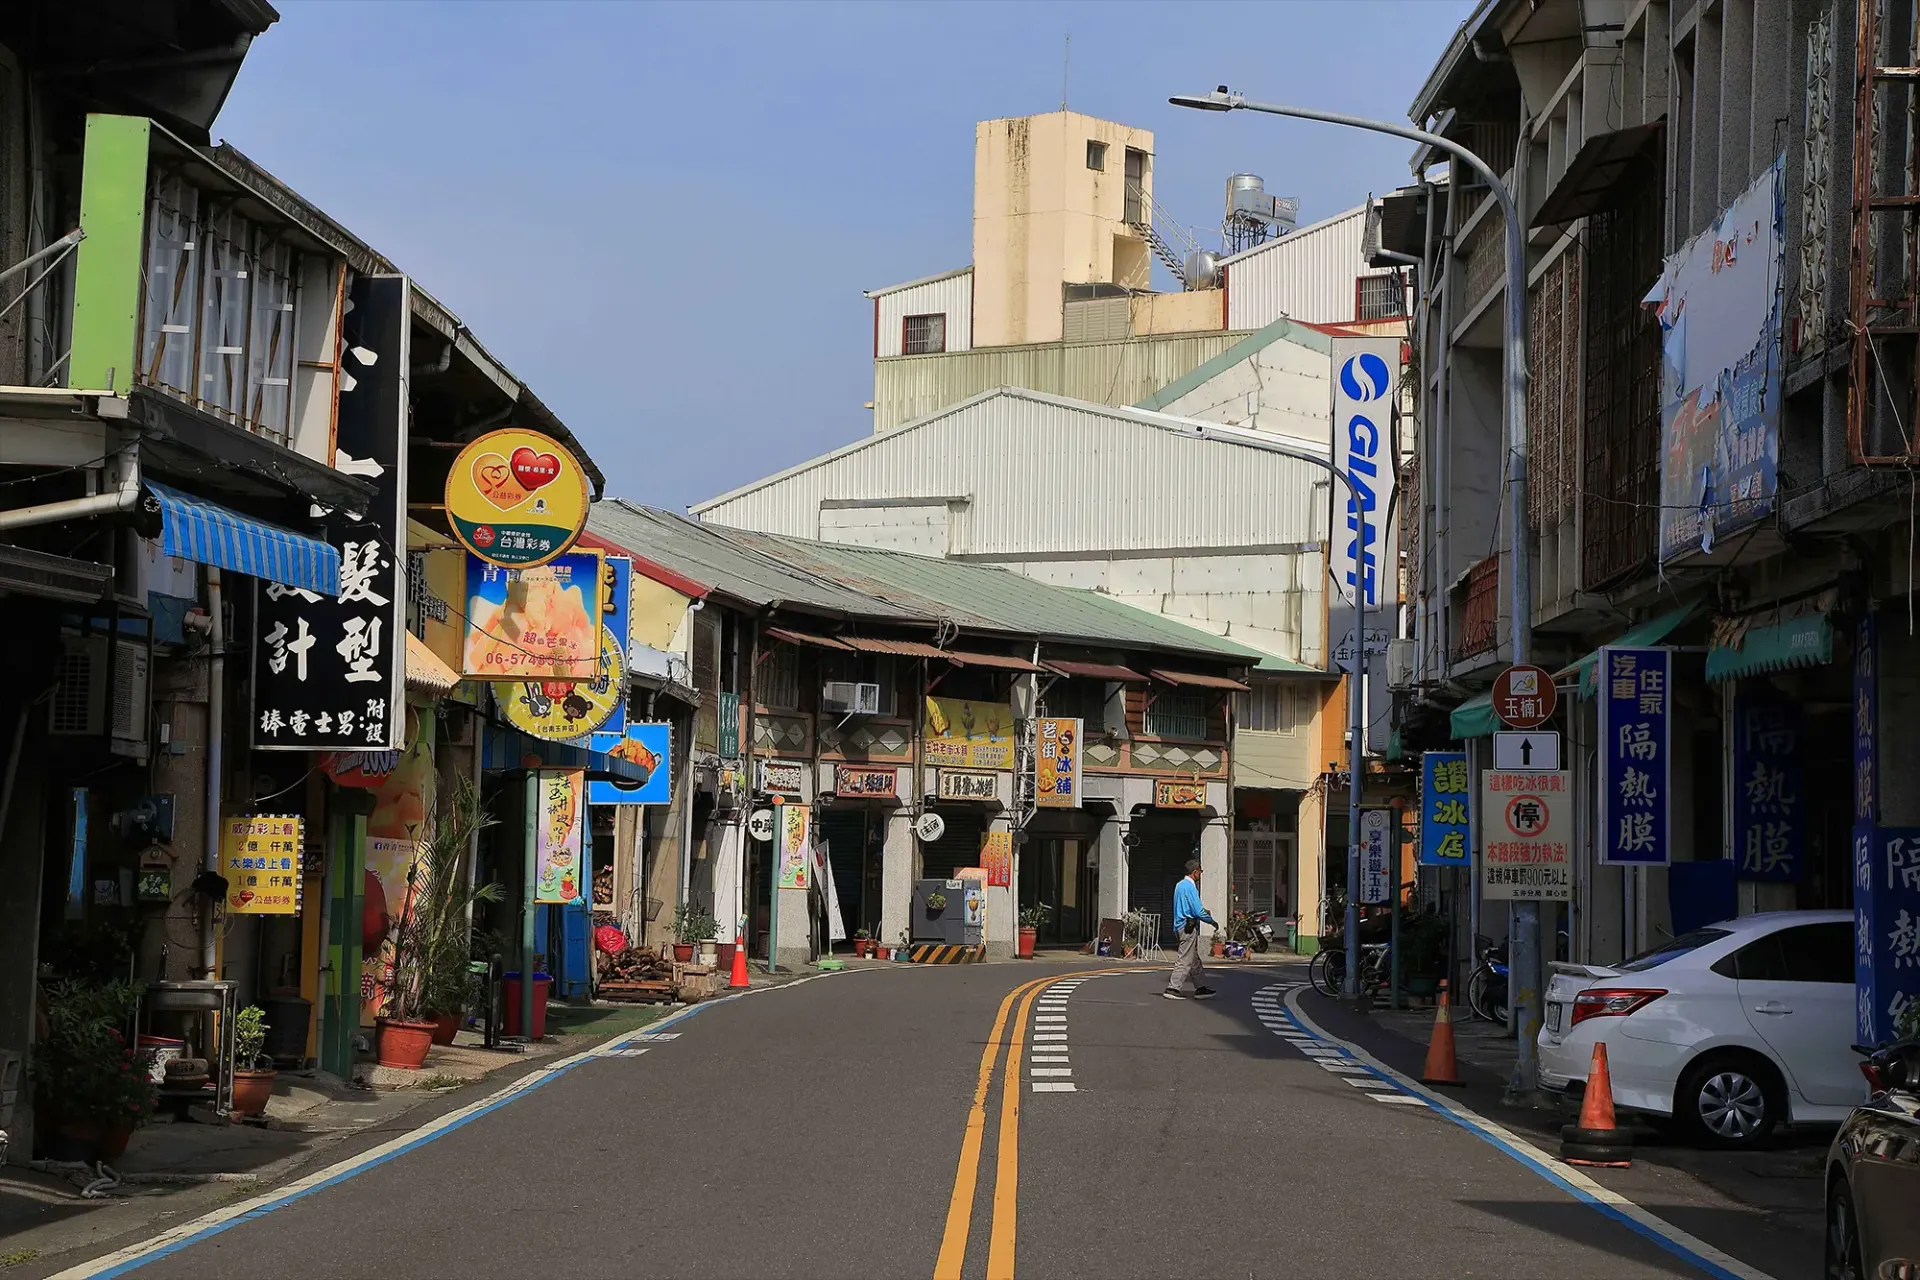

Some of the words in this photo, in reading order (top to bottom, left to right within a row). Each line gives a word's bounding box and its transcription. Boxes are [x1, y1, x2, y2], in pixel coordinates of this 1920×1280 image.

[492, 490, 522, 501] 公益彩券
[1347, 414, 1378, 605] GIANT
[500, 536, 551, 552] 台灣彩券
[1612, 655, 1637, 700] 汽車
[1639, 669, 1664, 715] 住家
[1504, 697, 1546, 719] 玉楠1
[1856, 619, 1872, 819] 隔熱膜
[1041, 721, 1058, 760] 老街
[1489, 774, 1567, 793] 這樣吃冰很貴!
[1617, 722, 1657, 853] 隔熱膜
[1742, 704, 1796, 875] 隔熱膜
[1513, 802, 1540, 829] 停
[231, 823, 294, 836] 威力彩上看
[229, 858, 292, 870] 大樂透上看
[1367, 829, 1383, 902] 享樂遊玉井
[1487, 842, 1568, 865] 本路段強力執法!
[1487, 868, 1568, 885] 違規停車罰900元以上
[254, 895, 290, 905] 公益彩券
[1855, 835, 1875, 1043] 隔熱紙
